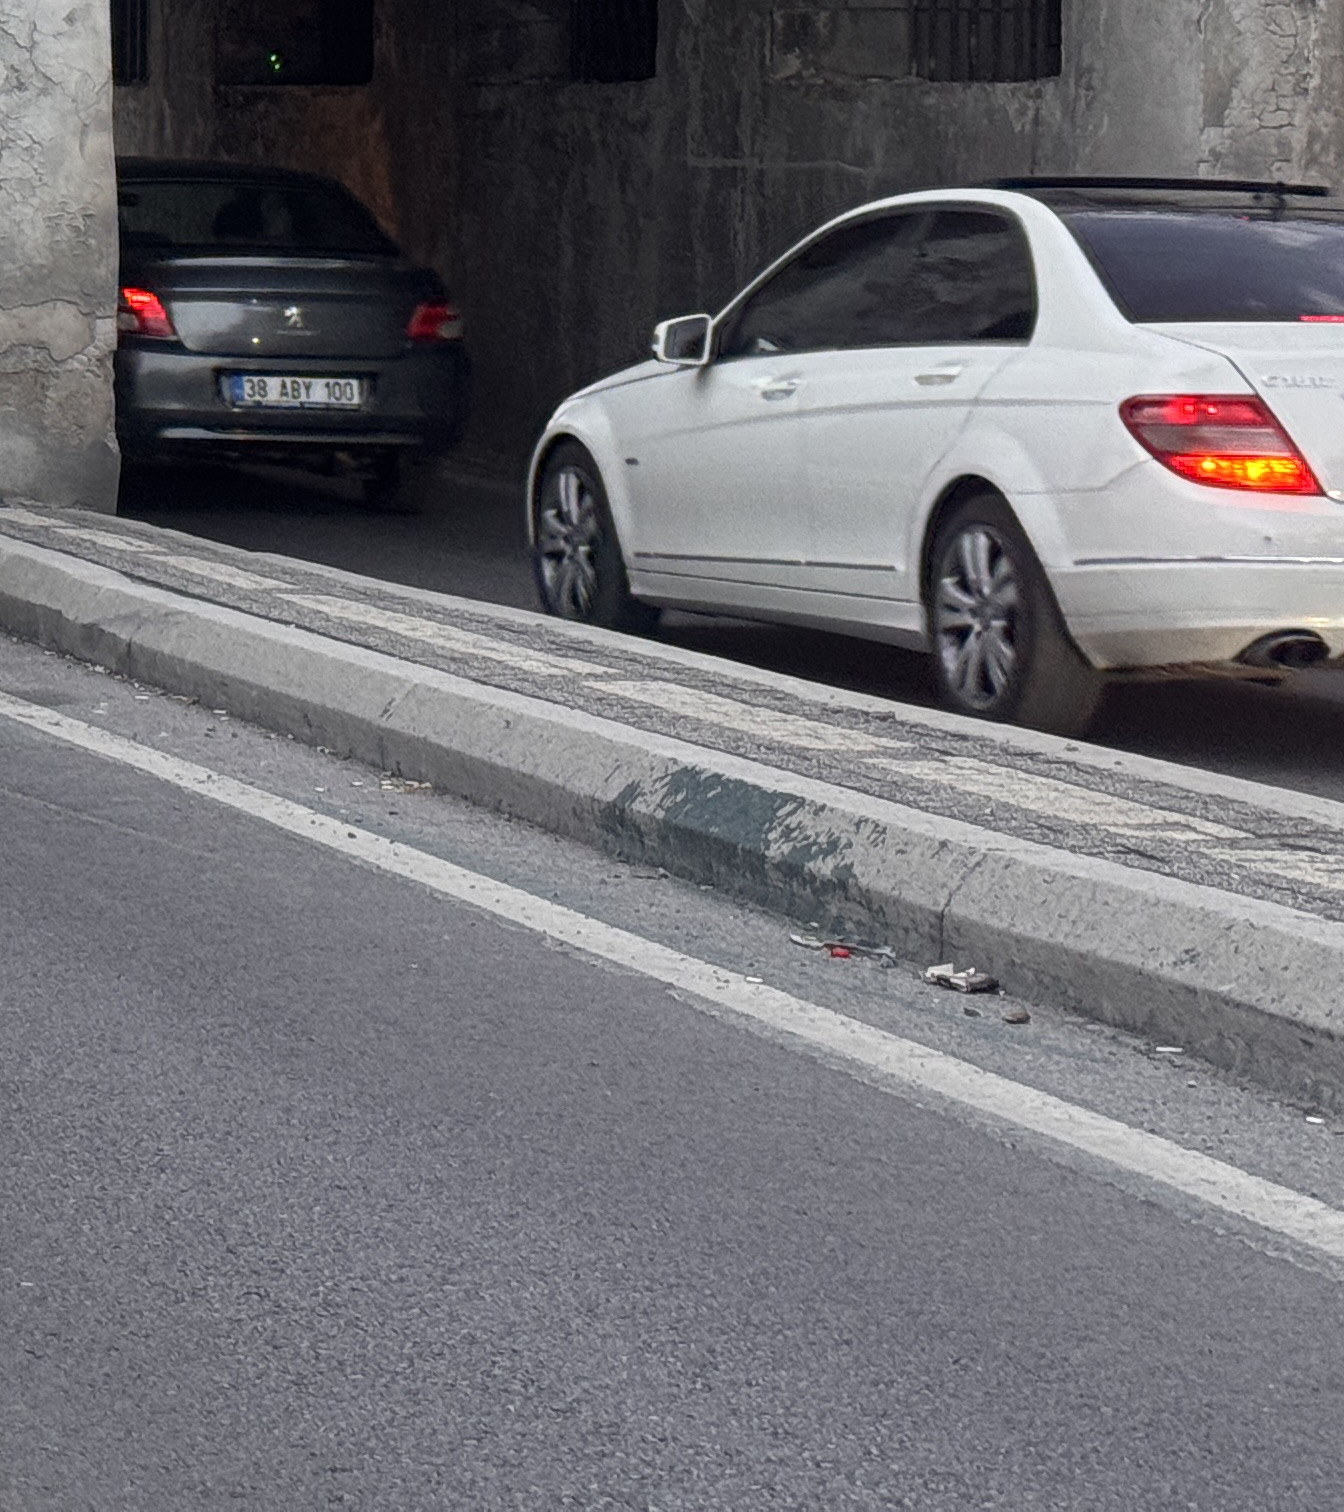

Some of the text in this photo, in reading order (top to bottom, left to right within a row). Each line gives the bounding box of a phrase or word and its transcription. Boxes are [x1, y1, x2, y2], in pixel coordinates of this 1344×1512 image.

[245, 378, 355, 402] 38 ABY 100
